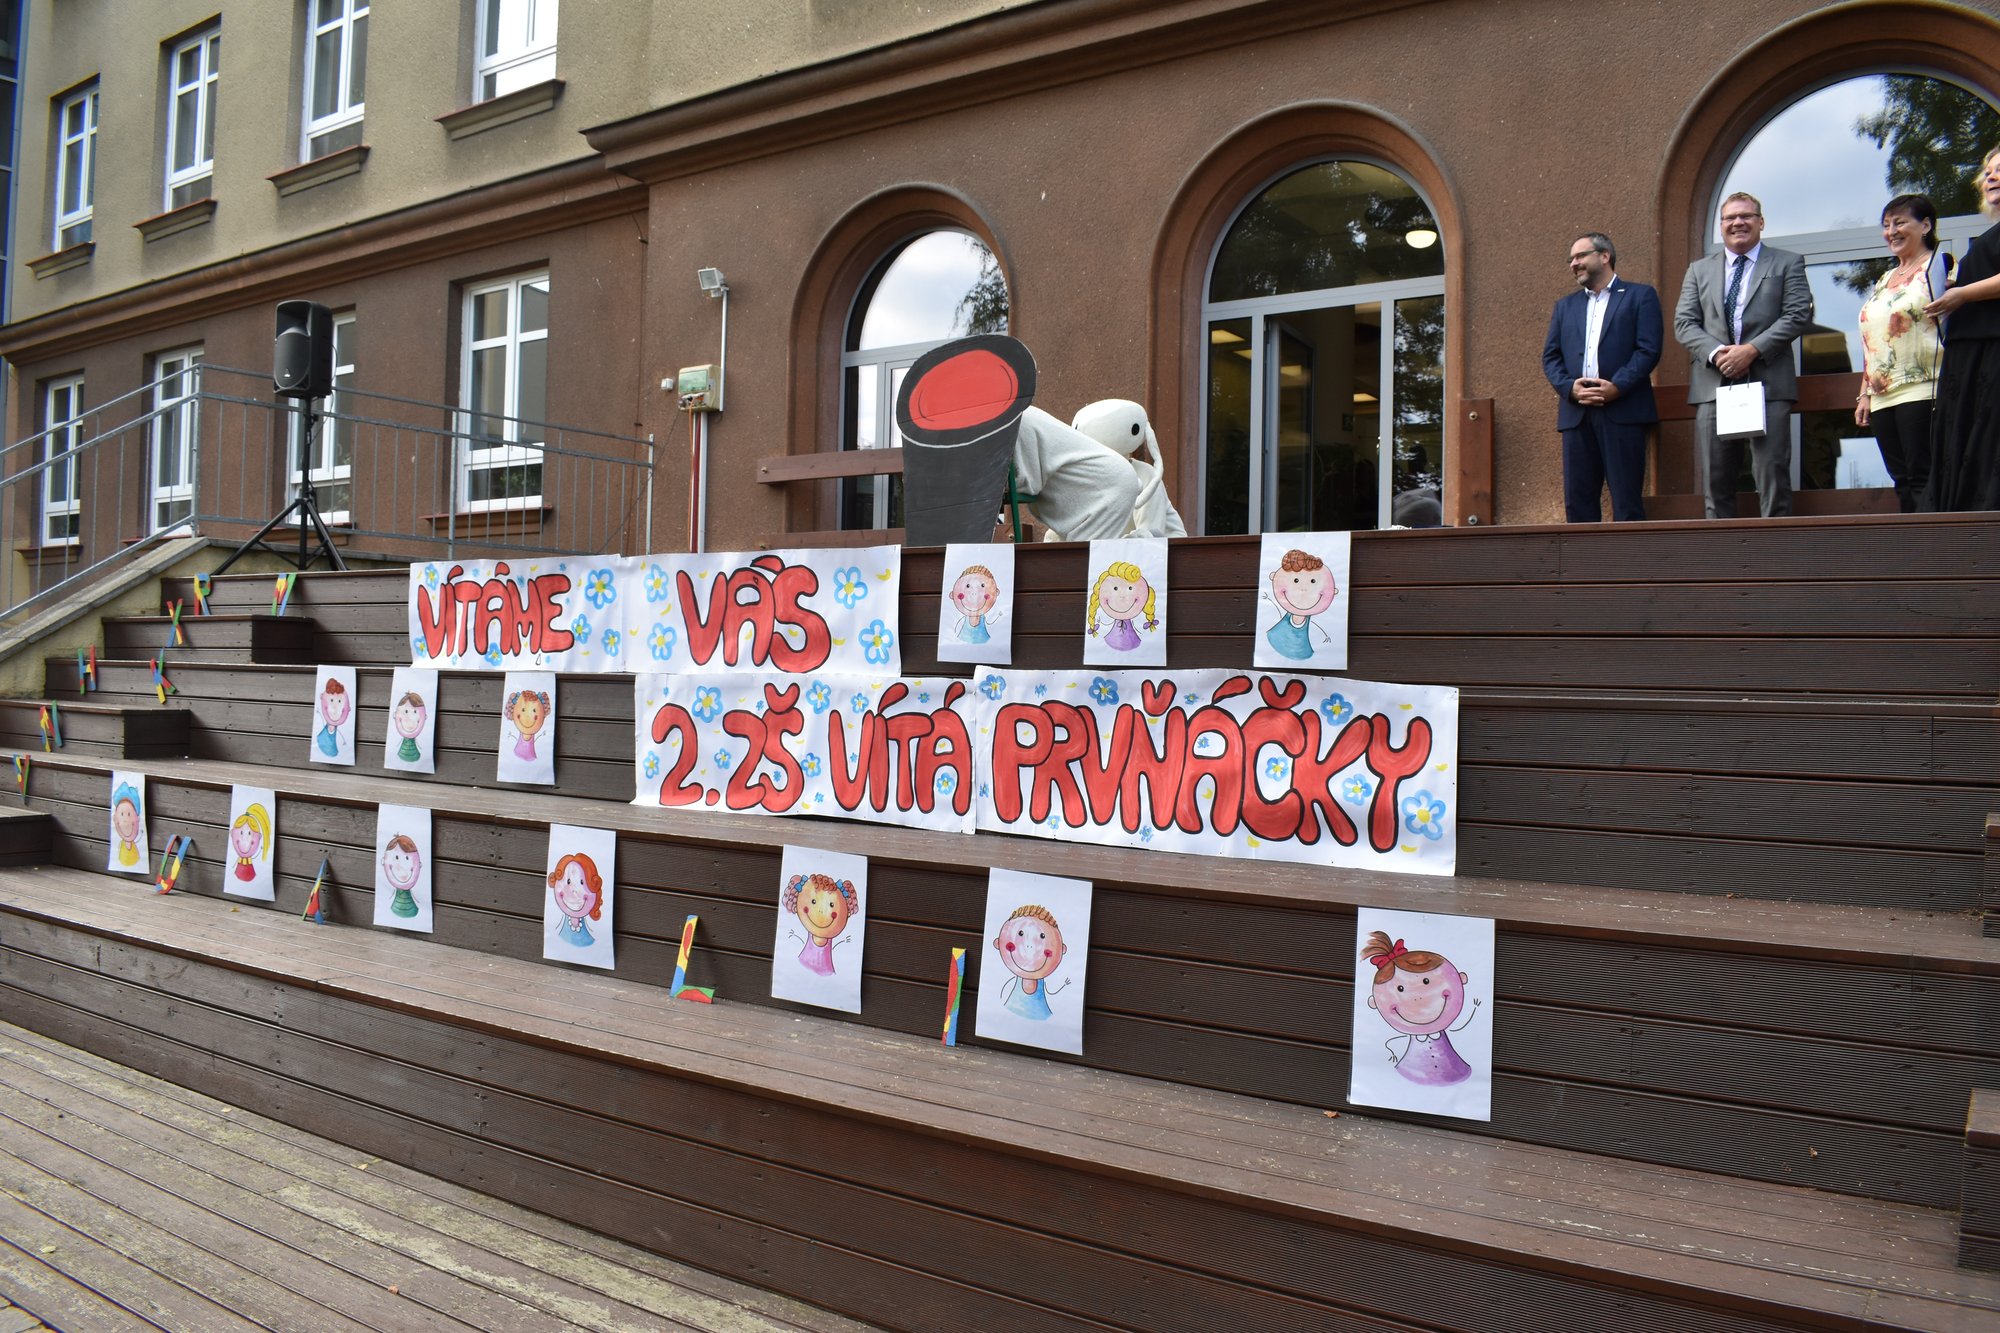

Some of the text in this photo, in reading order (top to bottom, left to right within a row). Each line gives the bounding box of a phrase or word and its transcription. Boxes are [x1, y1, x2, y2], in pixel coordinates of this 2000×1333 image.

[418, 555, 832, 673] VÍTÁME VÁS
[828, 681, 974, 817] VÍTÁ
[992, 675, 1433, 854] PRVŇÁČKY
